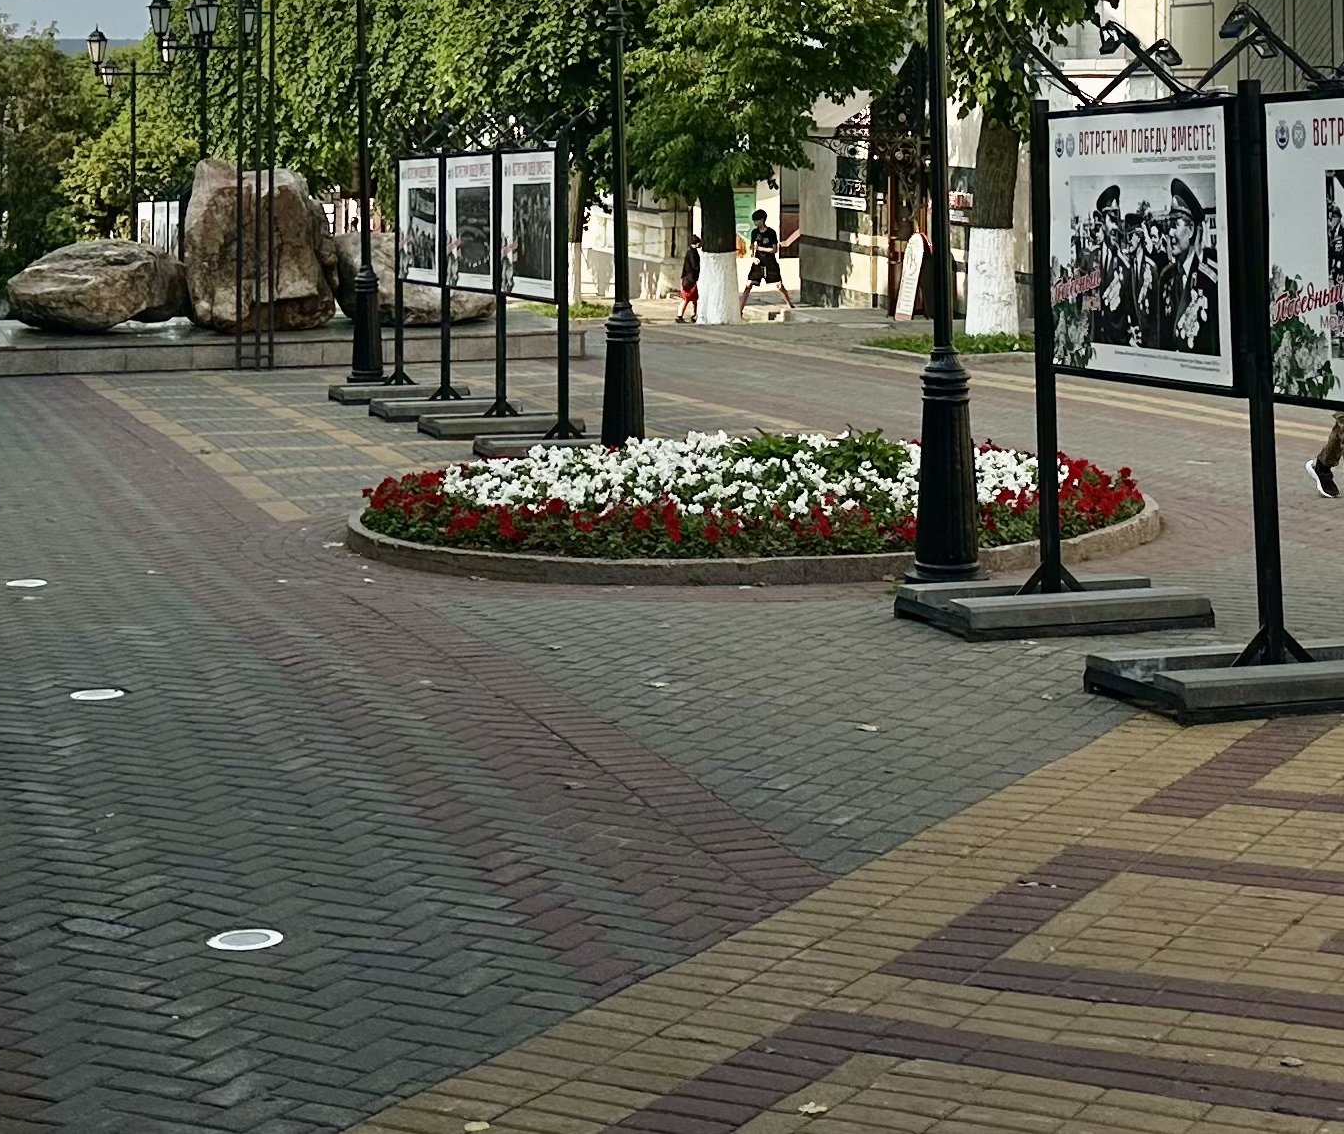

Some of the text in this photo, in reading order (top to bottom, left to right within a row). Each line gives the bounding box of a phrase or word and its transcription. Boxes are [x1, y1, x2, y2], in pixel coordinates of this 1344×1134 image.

[1078, 123, 1216, 156] ВСТРЕТИМ ПОБЕДУ ВМЕСТЕ!
[1272, 274, 1344, 324] Победный
